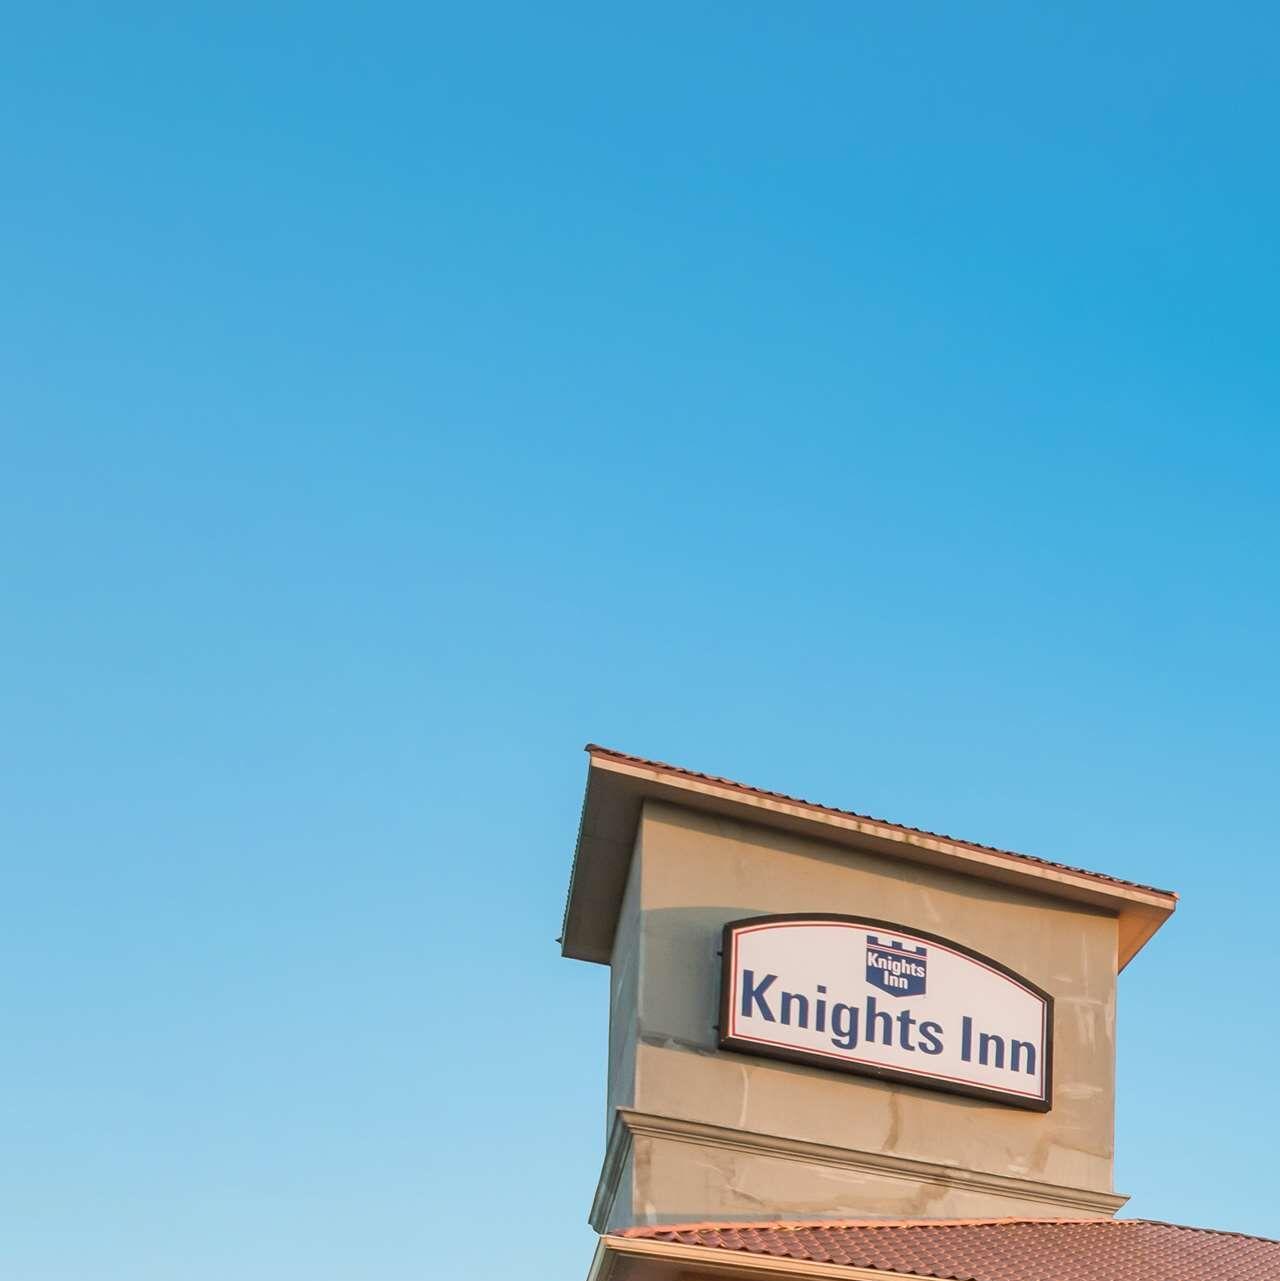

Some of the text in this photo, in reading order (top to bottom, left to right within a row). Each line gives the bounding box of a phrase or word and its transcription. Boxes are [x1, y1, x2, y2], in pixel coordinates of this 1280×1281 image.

[867, 951, 926, 978] Knights
[883, 970, 909, 990] Inn
[741, 969, 1036, 1076] Knights Inn
